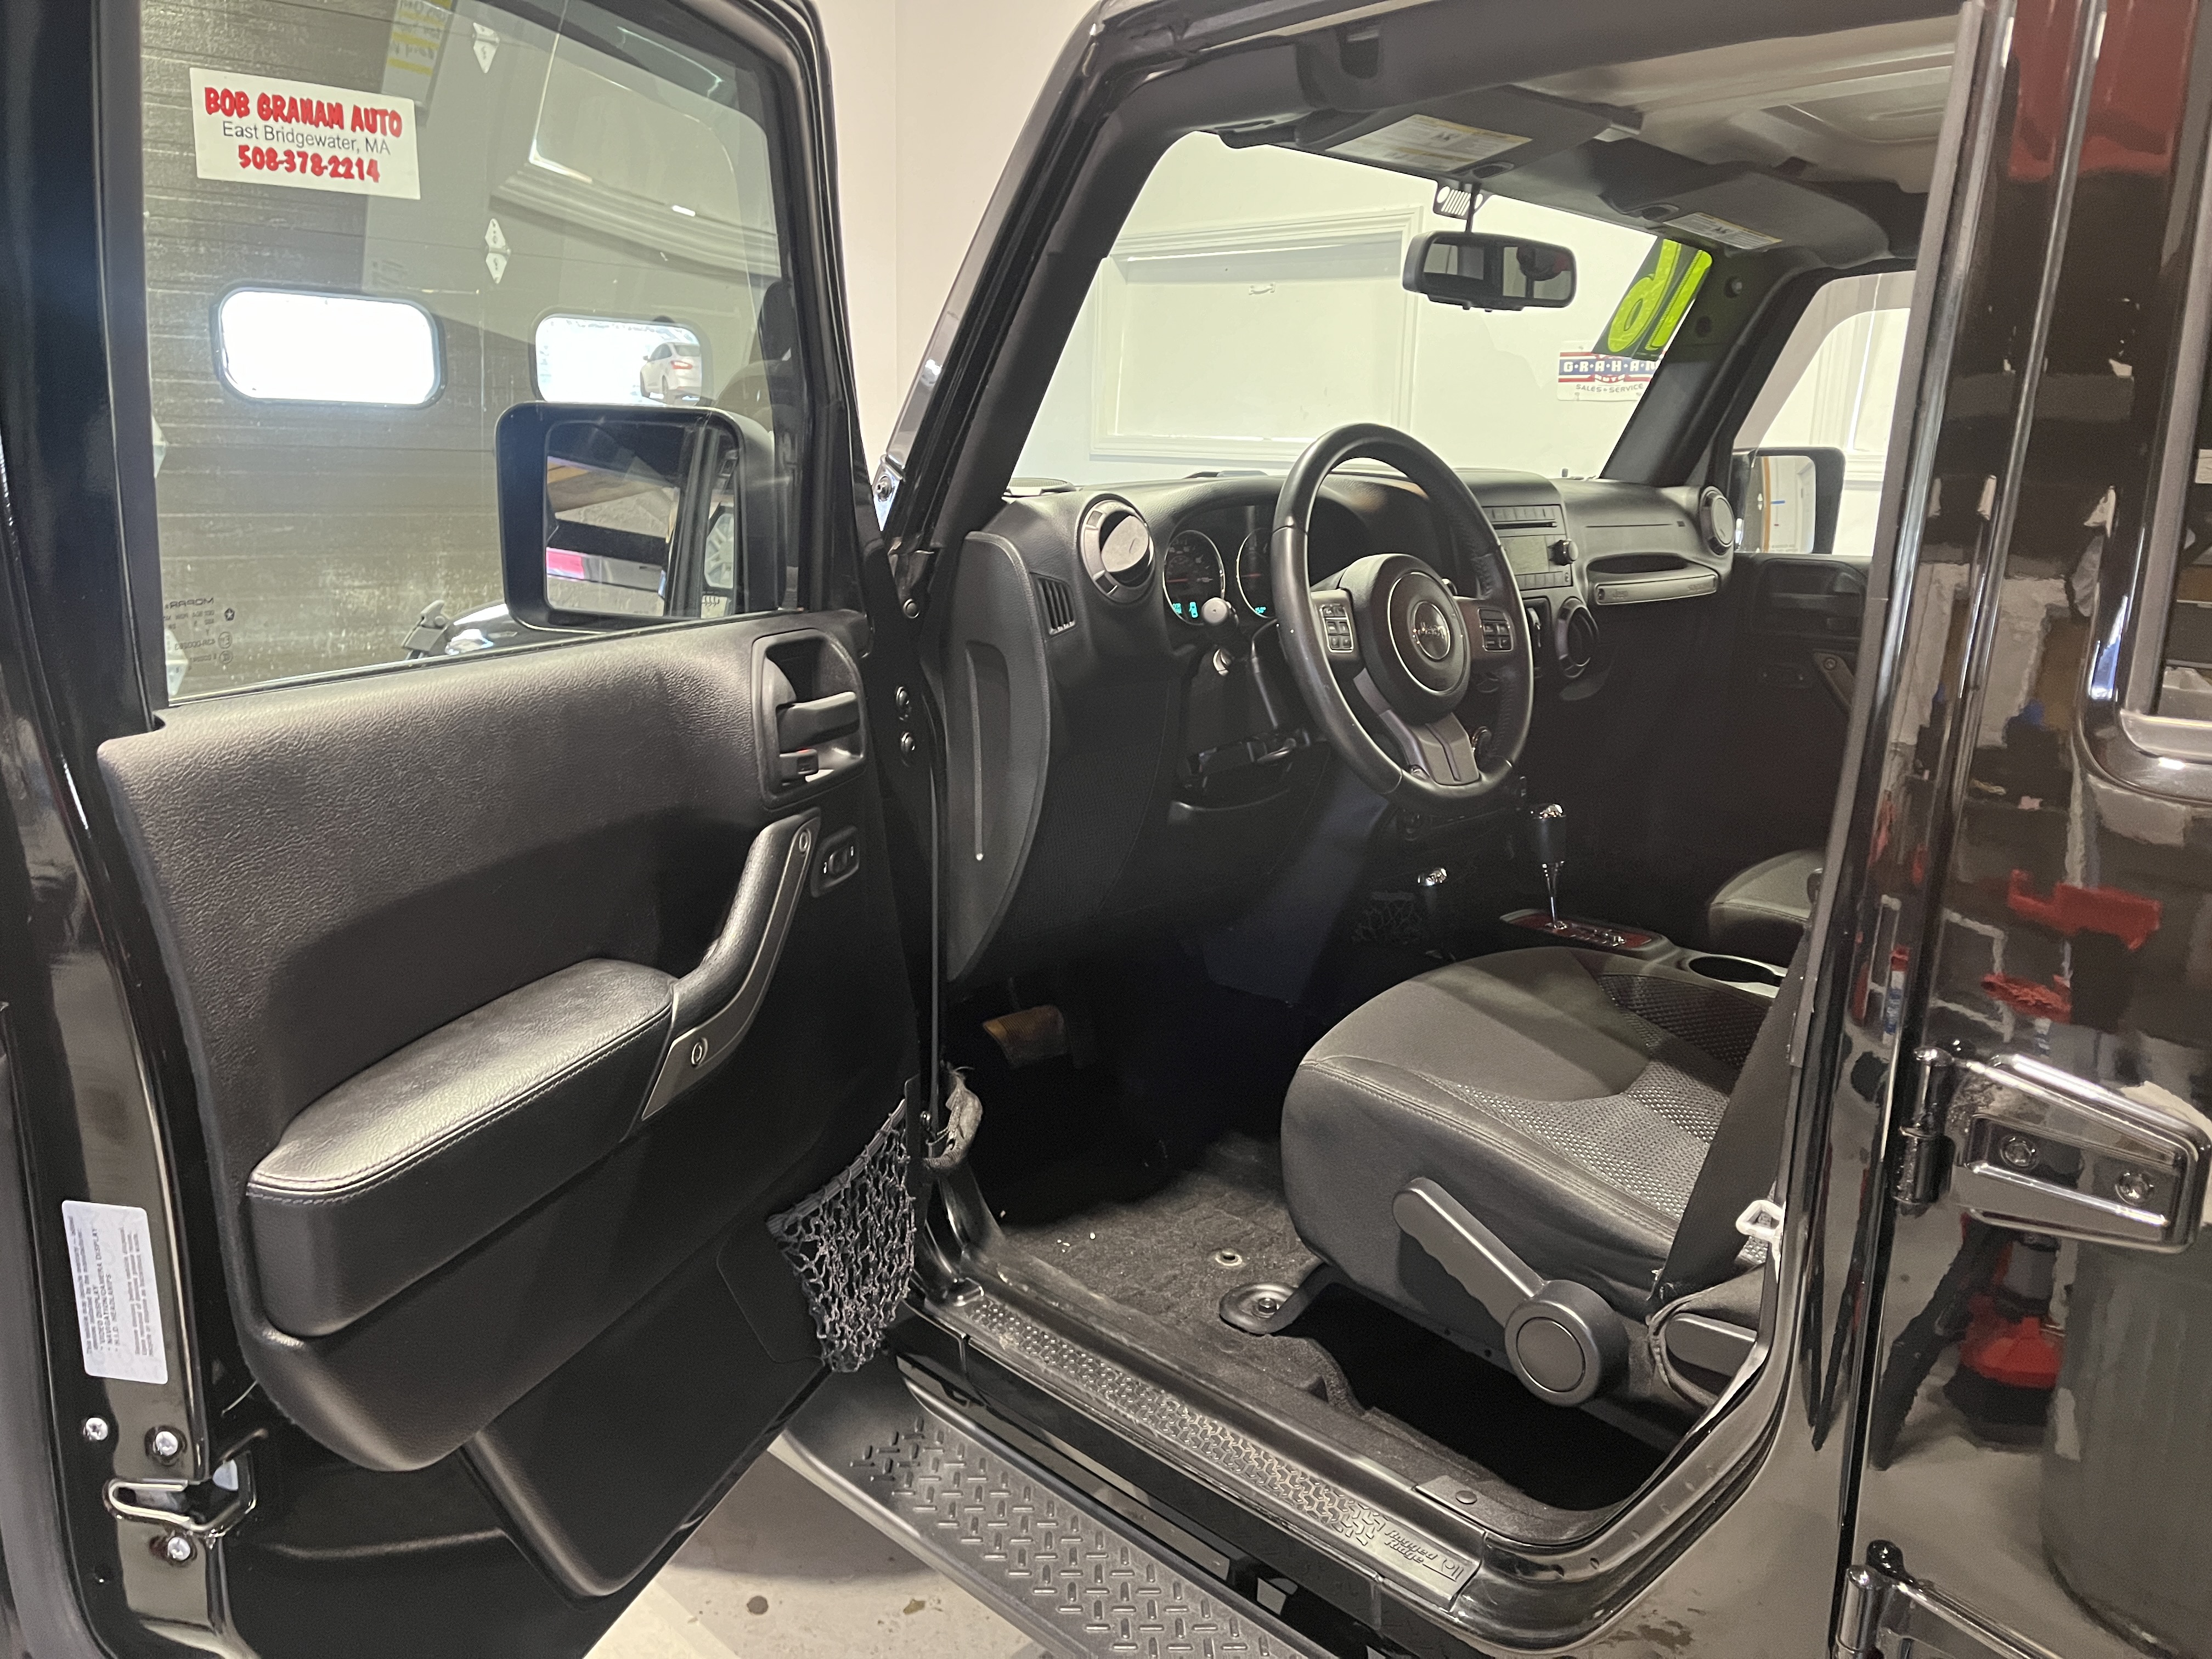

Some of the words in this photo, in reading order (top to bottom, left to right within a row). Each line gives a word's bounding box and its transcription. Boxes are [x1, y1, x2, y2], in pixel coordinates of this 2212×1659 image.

[205, 87, 250, 119] BOB
[257, 92, 345, 130] GRAHAM
[351, 104, 403, 138] AUTO
[223, 121, 258, 140] East
[264, 125, 360, 154] Bridgewater,
[365, 139, 391, 155] MA
[238, 145, 381, 183] 508-378-2214
[1576, 384, 1602, 392] SALES
[1609, 383, 1644, 393] SERVICE
[1384, 1530, 1438, 1560] Rugged
[1384, 1540, 1424, 1564] Ridge
